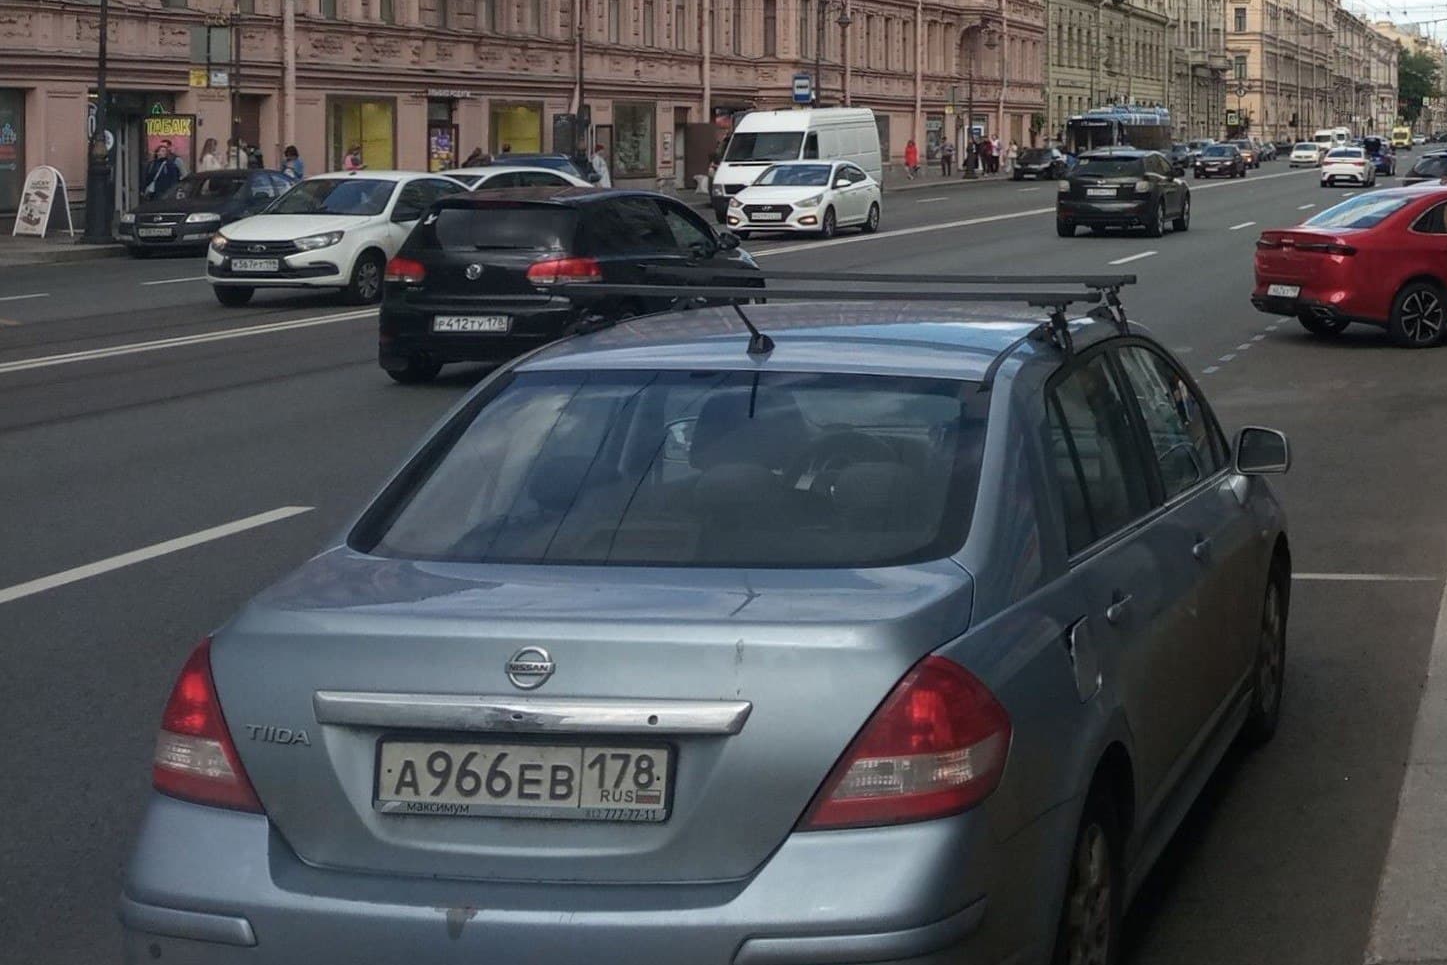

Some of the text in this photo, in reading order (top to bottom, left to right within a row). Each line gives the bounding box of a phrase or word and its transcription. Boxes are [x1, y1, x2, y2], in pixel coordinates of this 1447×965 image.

[144, 118, 192, 136] ТАБАК
[509, 663, 549, 672] NISSAN
[246, 723, 311, 746] TIIDA
[394, 750, 656, 801] А966ЕВ 178
[600, 789, 635, 803] RUS
[406, 802, 470, 815] максимум
